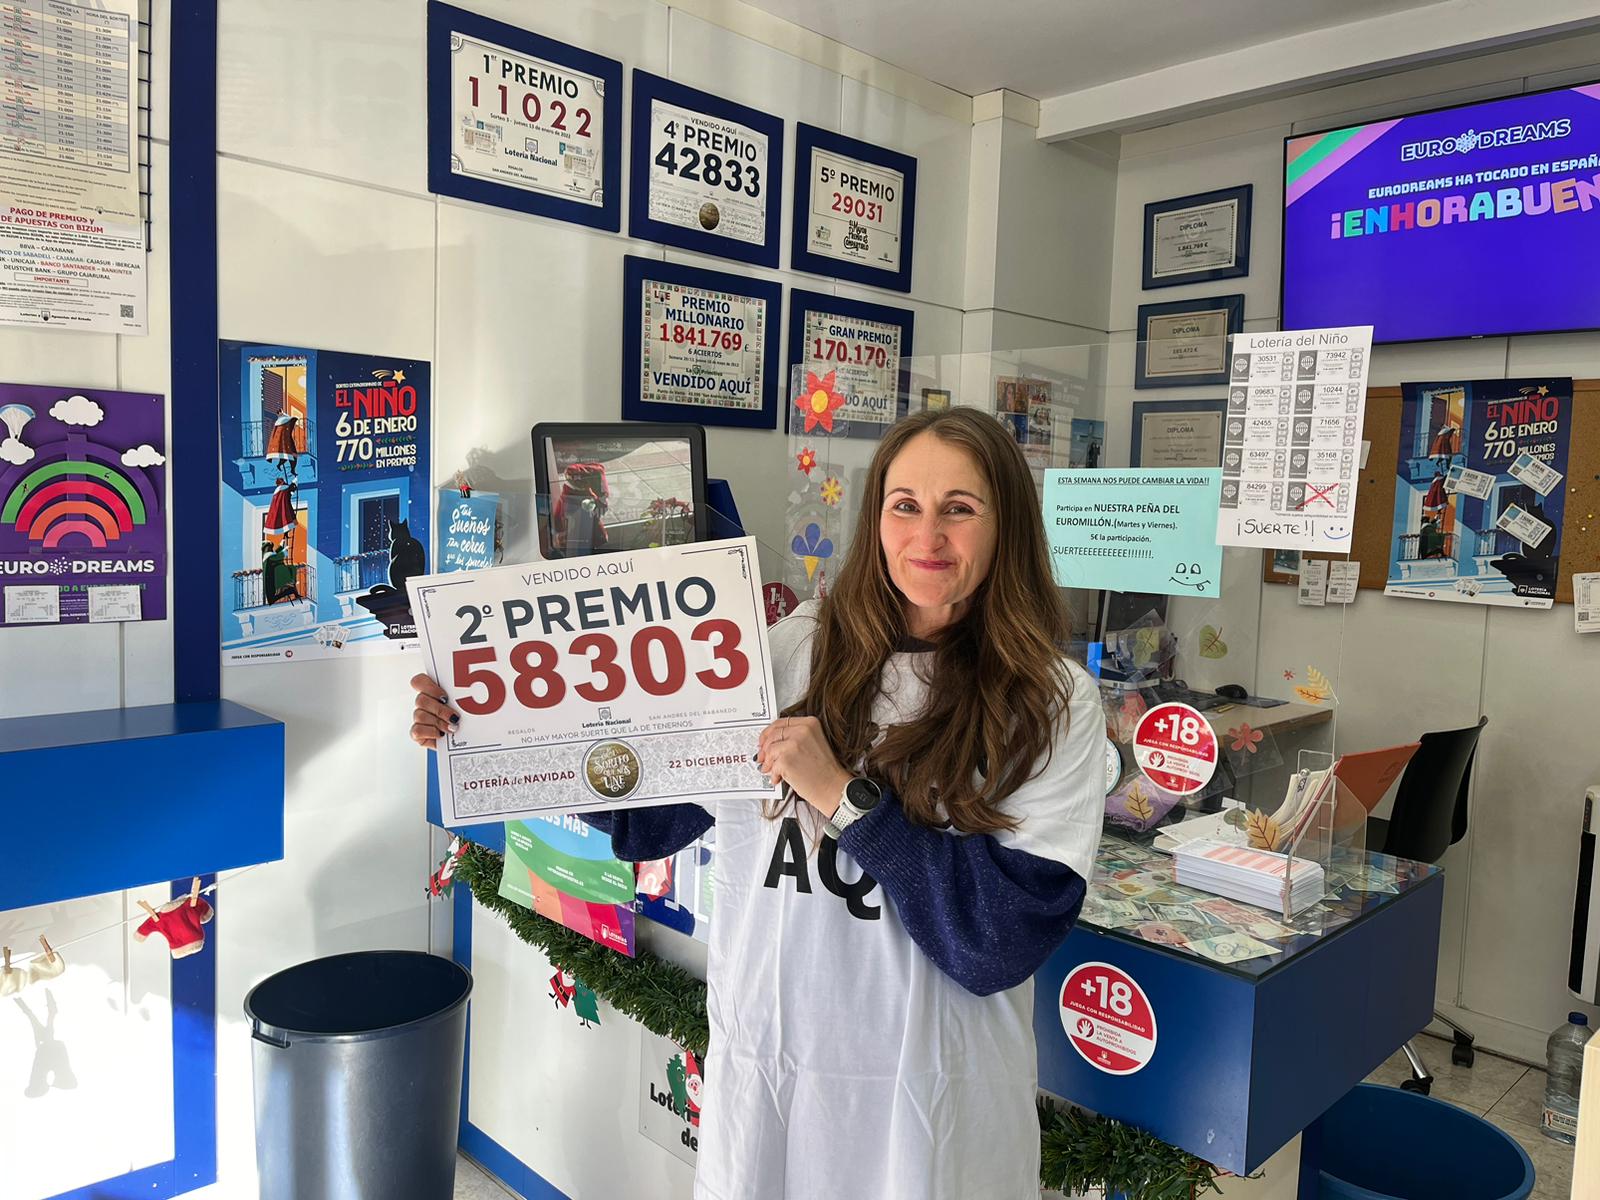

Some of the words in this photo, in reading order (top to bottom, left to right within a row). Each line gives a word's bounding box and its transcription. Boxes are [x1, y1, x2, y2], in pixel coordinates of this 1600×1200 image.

[502, 59, 578, 98] PREMIO
[691, 117, 720, 131] VENDIDO
[722, 124, 737, 136] AQUÍ
[684, 125, 756, 162] PREMIO
[1401, 137, 1456, 162] EURO
[1478, 118, 1571, 150] DREAMS
[504, 148, 529, 161] Lotería
[530, 152, 558, 166] Nacional
[655, 142, 760, 198] 42833
[1368, 176, 1454, 198] EURODREAMS
[1455, 174, 1474, 186] HA
[1476, 166, 1528, 184] TOCADO
[1531, 163, 1550, 176] EN
[1552, 154, 1600, 172] ESPAÑ
[820, 166, 836, 183] 5º
[840, 172, 894, 202] PREMIO
[10, 207, 34, 216] PAGO
[36, 210, 46, 218] DE
[50, 212, 88, 223] PREMIOS
[832, 192, 882, 222] 29031
[15, 217, 58, 228] APUESTAS
[76, 224, 104, 234] BIZUM
[1180, 221, 1208, 231] DIPLOMA
[62, 262, 96, 270] SANTANDER
[34, 276, 70, 284] IMPORTANTE
[682, 296, 730, 314] PREMIO
[666, 308, 744, 330] MILLONARIO
[829, 325, 854, 340] GRAN
[857, 330, 892, 345] PREMIO
[1172, 326, 1200, 334] DIPLOMA
[1250, 336, 1292, 349] Lotería
[1296, 334, 1315, 346] del
[1319, 333, 1348, 346] Niño
[693, 348, 722, 358] ACIERTOS
[814, 338, 886, 368] 170.170
[654, 372, 716, 390] VENDIDO
[719, 377, 751, 396] AQUÍ
[336, 390, 352, 407] EL
[354, 383, 416, 418] NIÑO
[862, 394, 888, 411] AQUÍ
[1488, 405, 1500, 418] EL
[1500, 396, 1558, 426] NIÑO
[336, 412, 352, 438] 6
[354, 419, 372, 436] DE
[374, 415, 416, 434] ENERO
[1166, 426, 1194, 434] DIPLOMA
[1484, 422, 1498, 441] 6
[1500, 426, 1516, 439] DE
[1518, 420, 1558, 436] ENERO
[336, 438, 372, 462] 770
[376, 444, 416, 458] MILLONES
[1484, 440, 1516, 460] 770
[1518, 443, 1556, 456] MILLONES
[376, 460, 386, 468] EN
[386, 457, 416, 468] PREMIOS
[1186, 477, 1210, 486] VIDA!!
[1056, 504, 1083, 513] Participa
[1094, 504, 1134, 513] NUESTRA
[1136, 502, 1160, 513] PEÑA
[1162, 504, 1180, 514] DEL
[449, 508, 490, 536] Sueños
[1146, 521, 1178, 530] Viernes).
[460, 535, 487, 554] cerca
[1107, 534, 1152, 543] participación.
[72, 560, 154, 574] DREAMS
[521, 566, 592, 588] VENDIDO
[596, 558, 634, 577] AQUÍ
[454, 604, 495, 644] 2º
[502, 576, 716, 640] PREMIO
[452, 618, 750, 716] 58303
[508, 728, 536, 736] REGALOS
[521, 736, 533, 744] NO
[535, 734, 550, 743] HAY
[552, 732, 578, 741] MAYOR
[580, 729, 608, 738] SUERTE
[652, 720, 693, 730] TENERNOS
[582, 720, 604, 728] Lotería
[605, 718, 632, 727] Nacional
[1154, 713, 1200, 746] +18
[669, 760, 684, 770] 22
[686, 754, 748, 768] DICIEMBRE
[508, 776, 524, 787] de
[524, 769, 576, 784] NAVIDAD
[1081, 976, 1132, 1016] +18
[1070, 1000, 1086, 1010] JUEGA
[1086, 1006, 1098, 1014] CON
[1098, 1011, 1146, 1033] RESPONSABILIDAD
[1096, 1025, 1122, 1038] PROHIBIDA
[1104, 1032, 1118, 1042] VENTA
[1096, 1036, 1136, 1056] AUTOPROHIBIDOS
[681, 1128, 698, 1152] de
